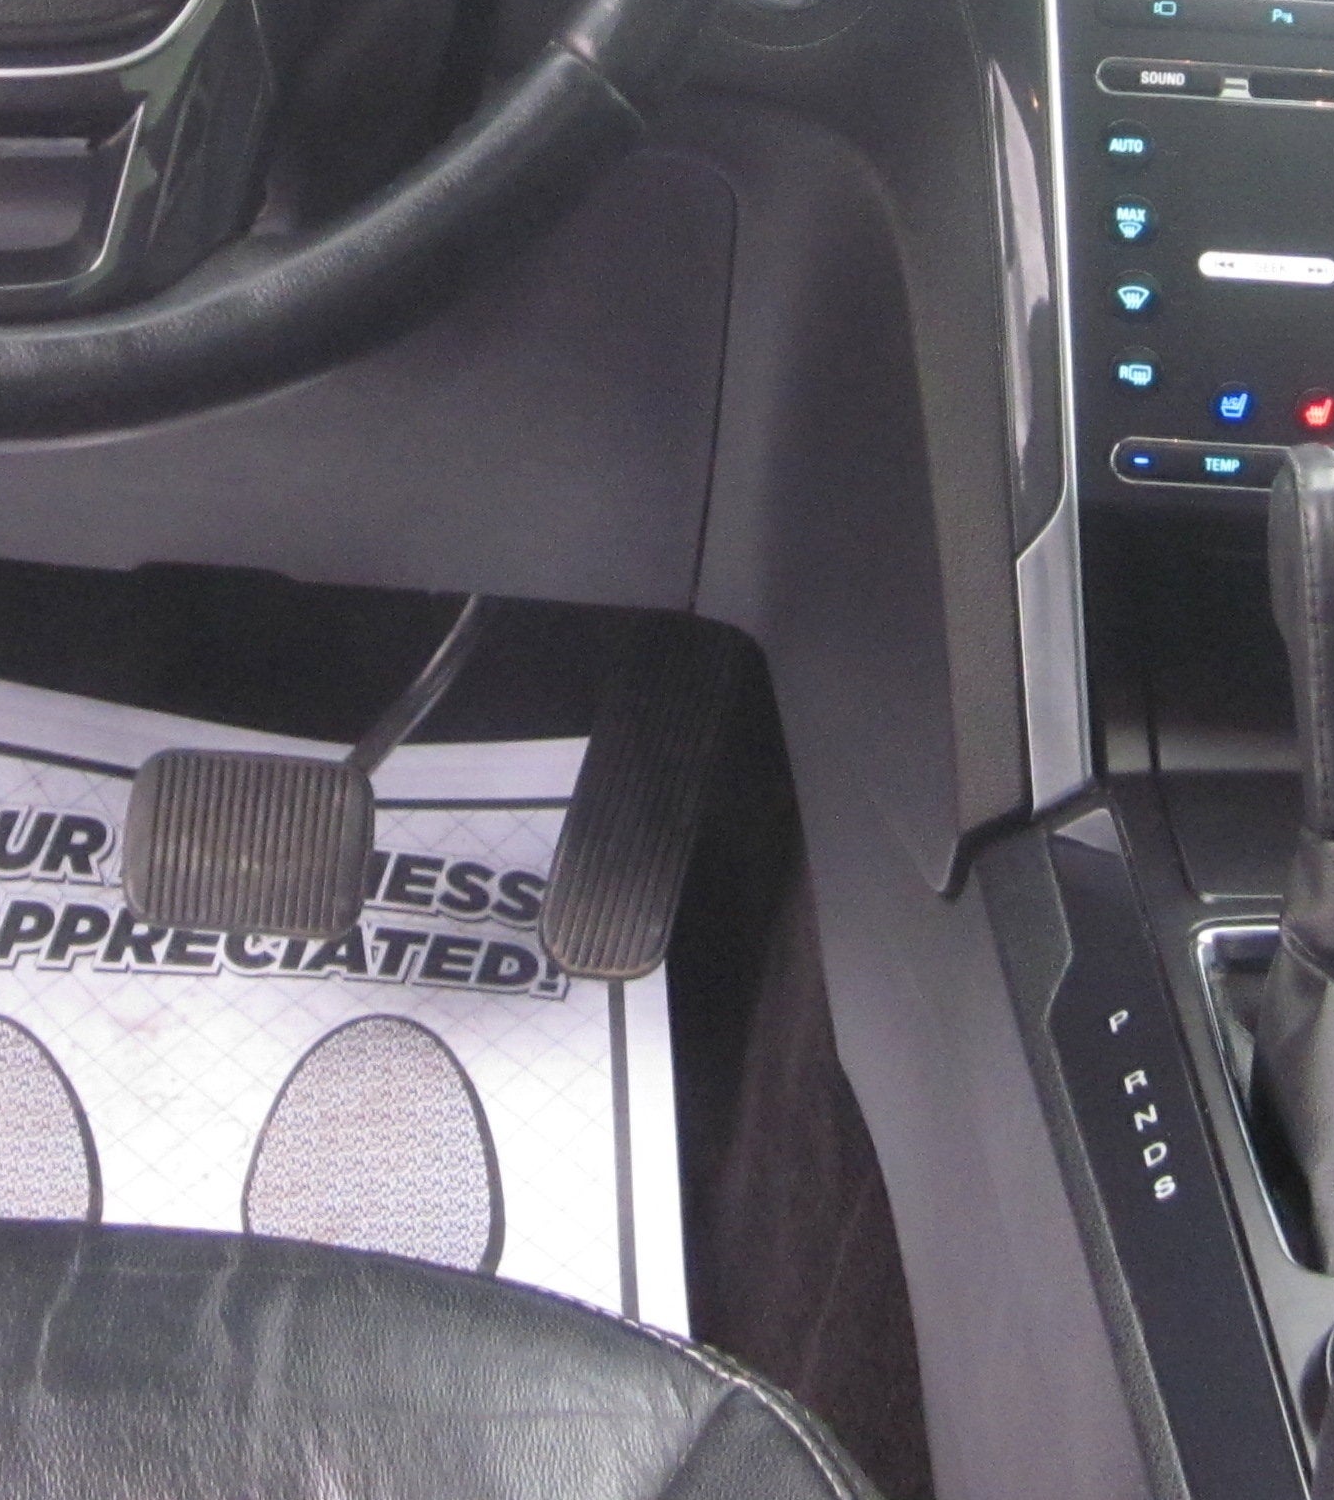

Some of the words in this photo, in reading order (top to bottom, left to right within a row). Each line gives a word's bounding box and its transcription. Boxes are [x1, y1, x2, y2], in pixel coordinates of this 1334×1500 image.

[1140, 70, 1186, 86] SOUND
[1108, 137, 1145, 154] AUTO
[1116, 207, 1146, 223] MAX
[1204, 457, 1241, 473] TEMP
[1108, 1008, 1129, 1034] P
[1124, 1069, 1148, 1095] R
[1133, 1103, 1158, 1132] N
[1142, 1141, 1168, 1168] D
[1154, 1174, 1177, 1200] S
